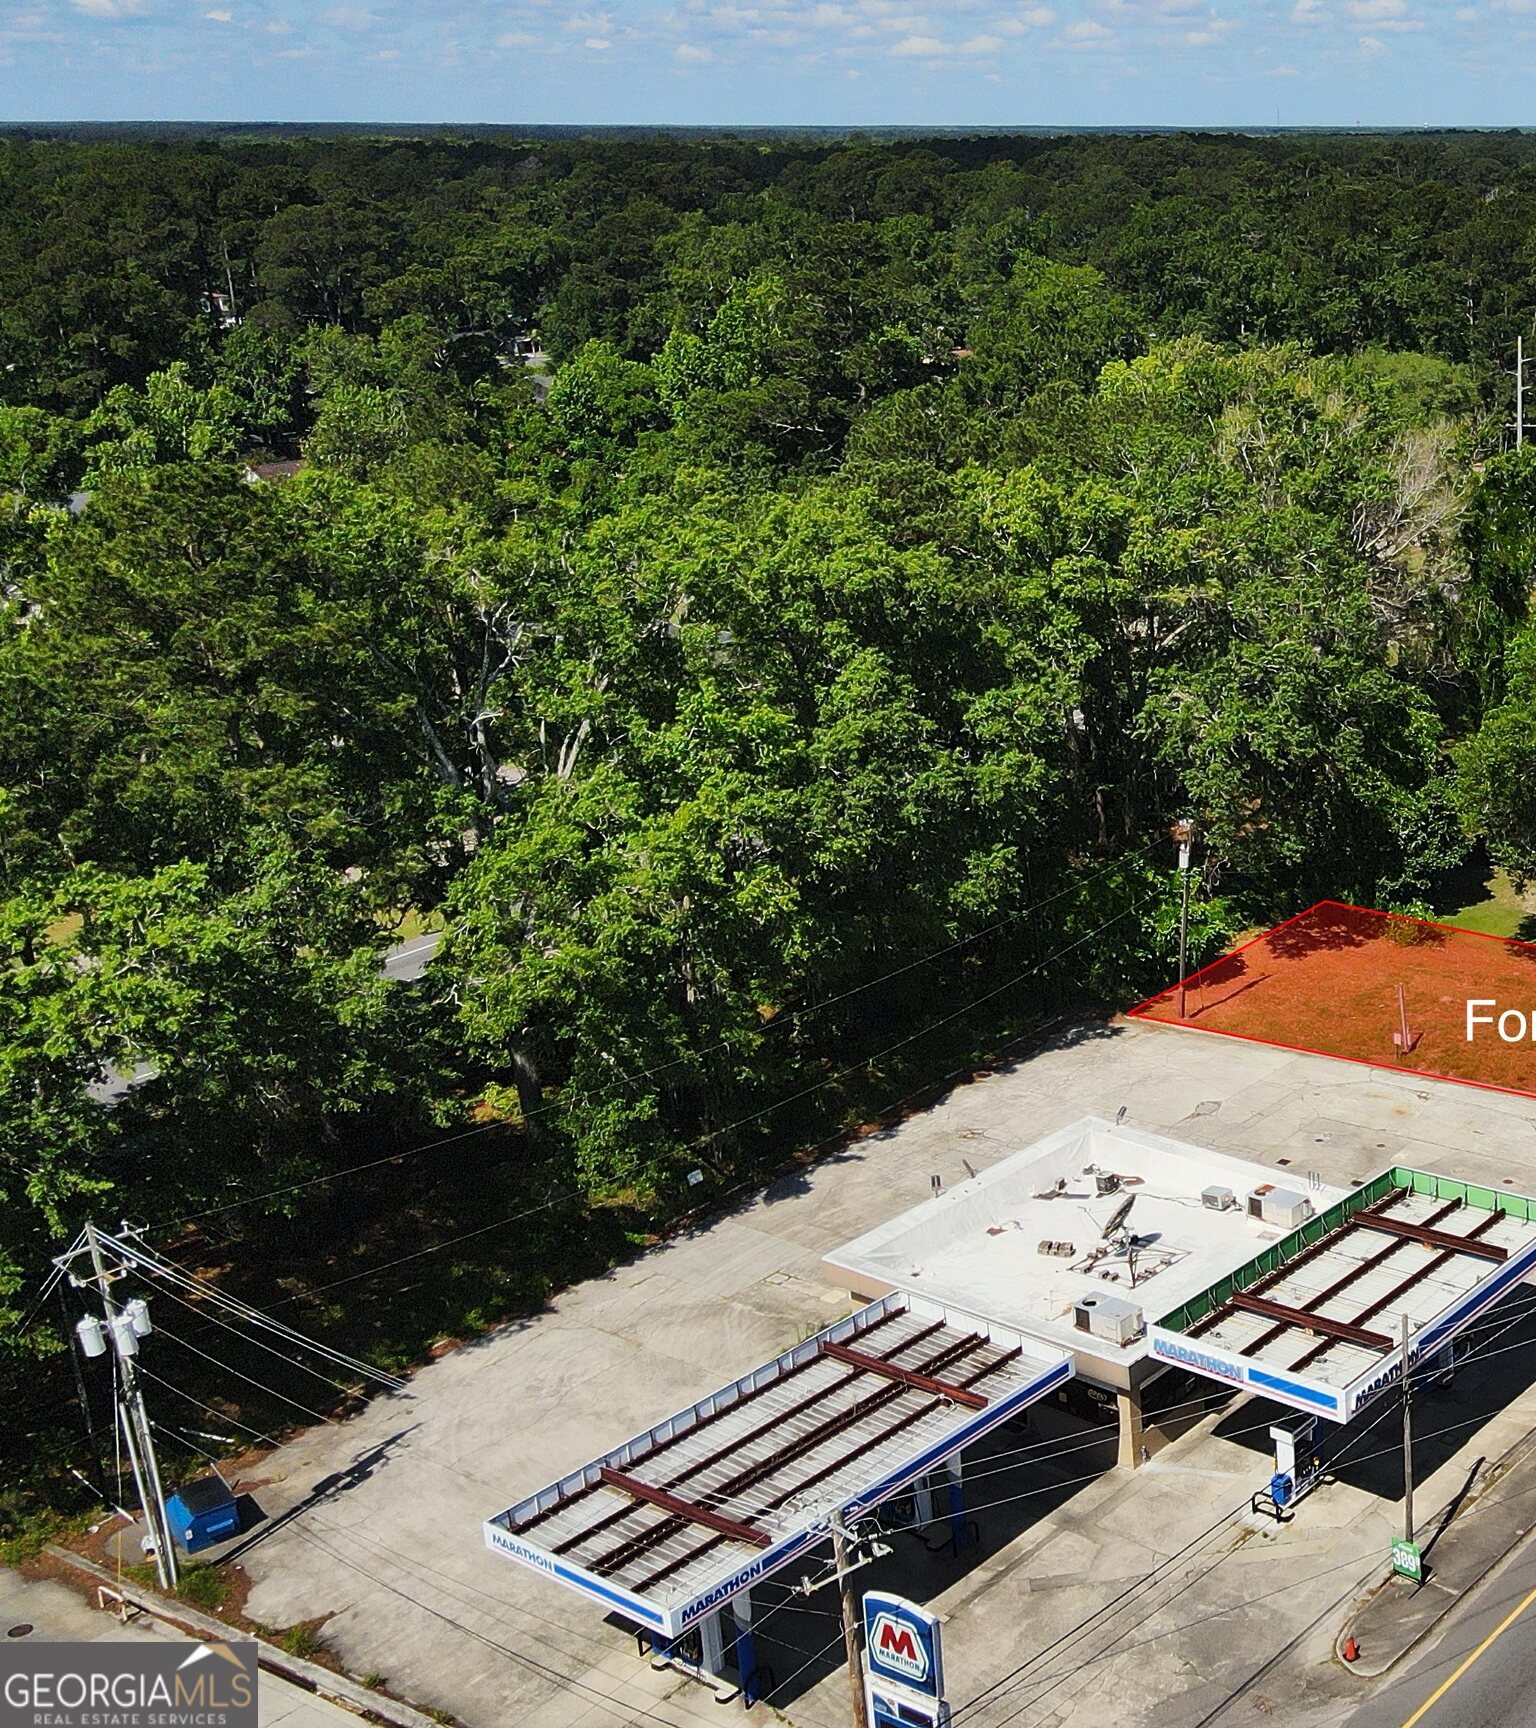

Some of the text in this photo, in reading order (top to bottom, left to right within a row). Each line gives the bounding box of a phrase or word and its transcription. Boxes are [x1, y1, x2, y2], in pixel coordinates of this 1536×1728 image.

[1153, 1338, 1244, 1382] MARATHON
[492, 1533, 554, 1572] MARATHON
[681, 1561, 763, 1624] MARATHON
[879, 1648, 920, 1672] MARATHON
